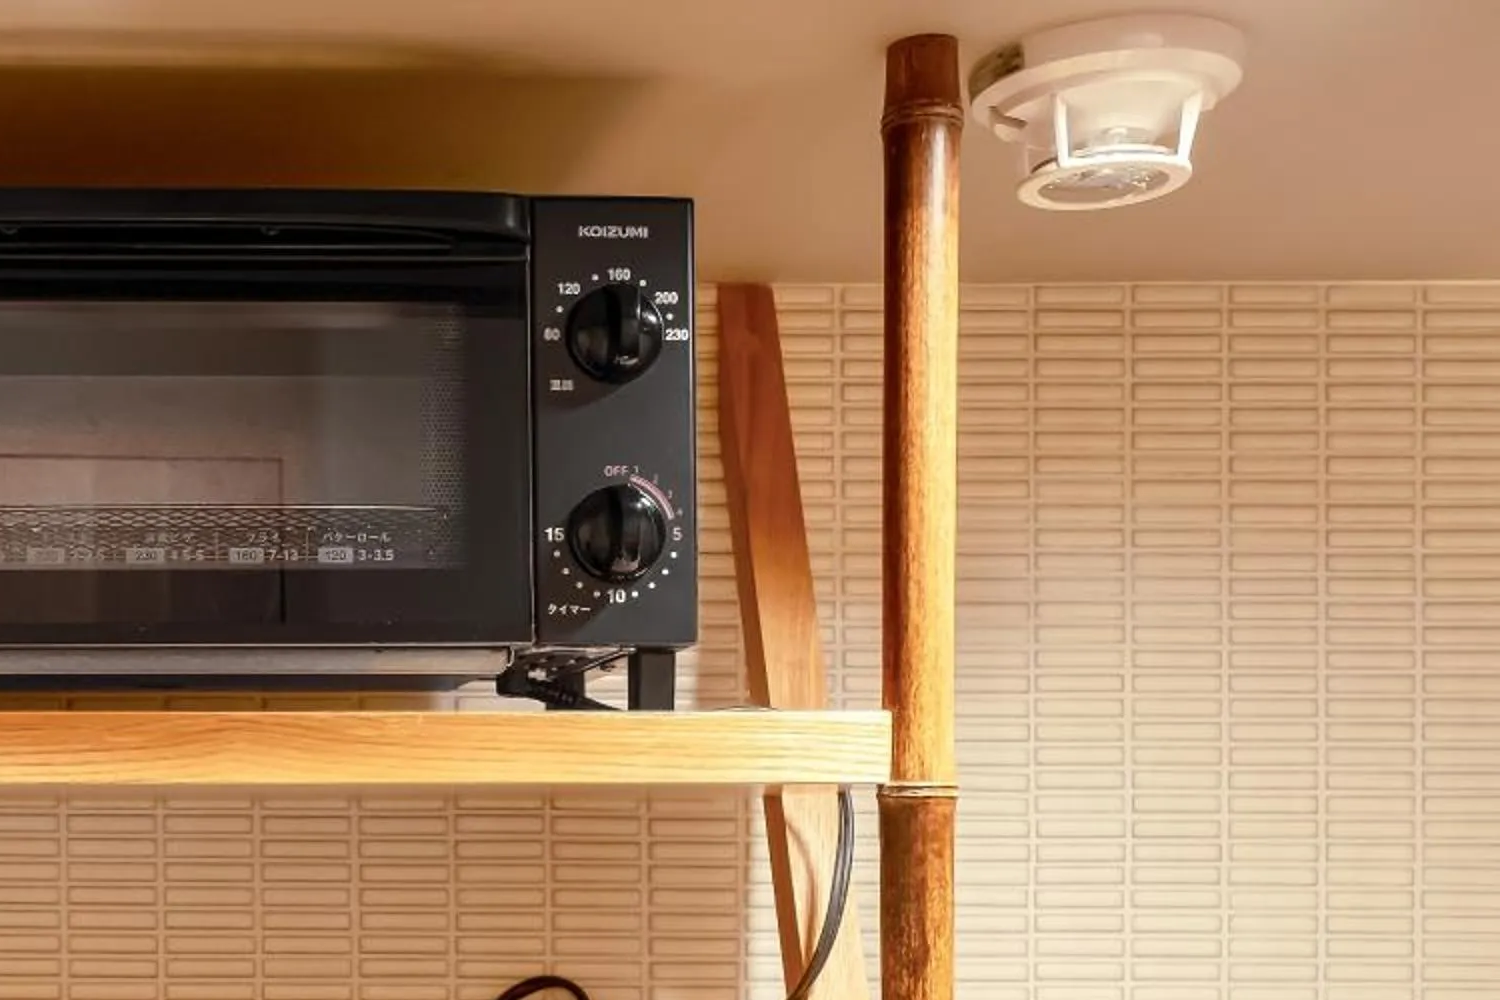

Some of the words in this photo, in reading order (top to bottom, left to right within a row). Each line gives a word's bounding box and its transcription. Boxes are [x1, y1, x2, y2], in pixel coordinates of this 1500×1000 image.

[578, 225, 649, 239] KOIZUMI
[607, 268, 631, 281] 160
[557, 283, 581, 295] 120
[654, 292, 678, 305] 200
[665, 328, 689, 341] 230
[604, 465, 629, 477] OFF
[544, 527, 565, 542] 15
[672, 527, 683, 541] 5
[607, 589, 627, 603] 10
[548, 604, 591, 614] タイマー
